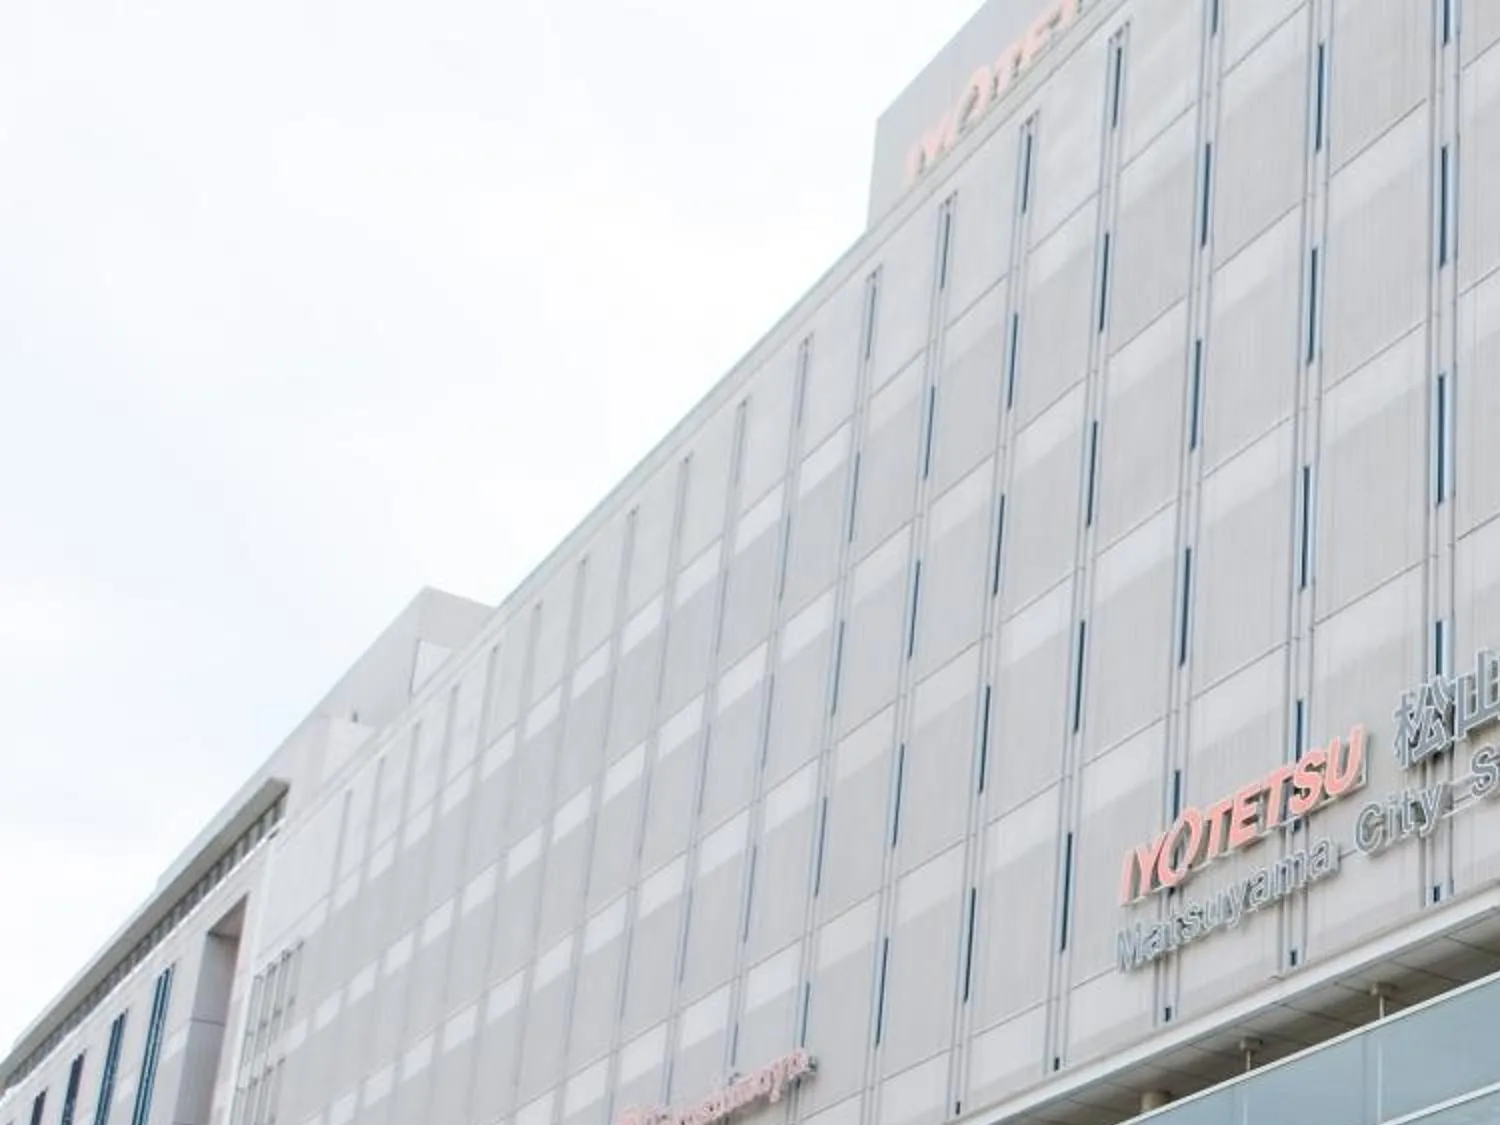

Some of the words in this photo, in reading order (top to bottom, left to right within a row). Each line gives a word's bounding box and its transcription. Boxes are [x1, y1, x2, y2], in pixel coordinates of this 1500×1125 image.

[1116, 834, 1341, 973] Matsuyama
[1354, 780, 1448, 857] City
[1120, 724, 1369, 904] IYOTETSU
